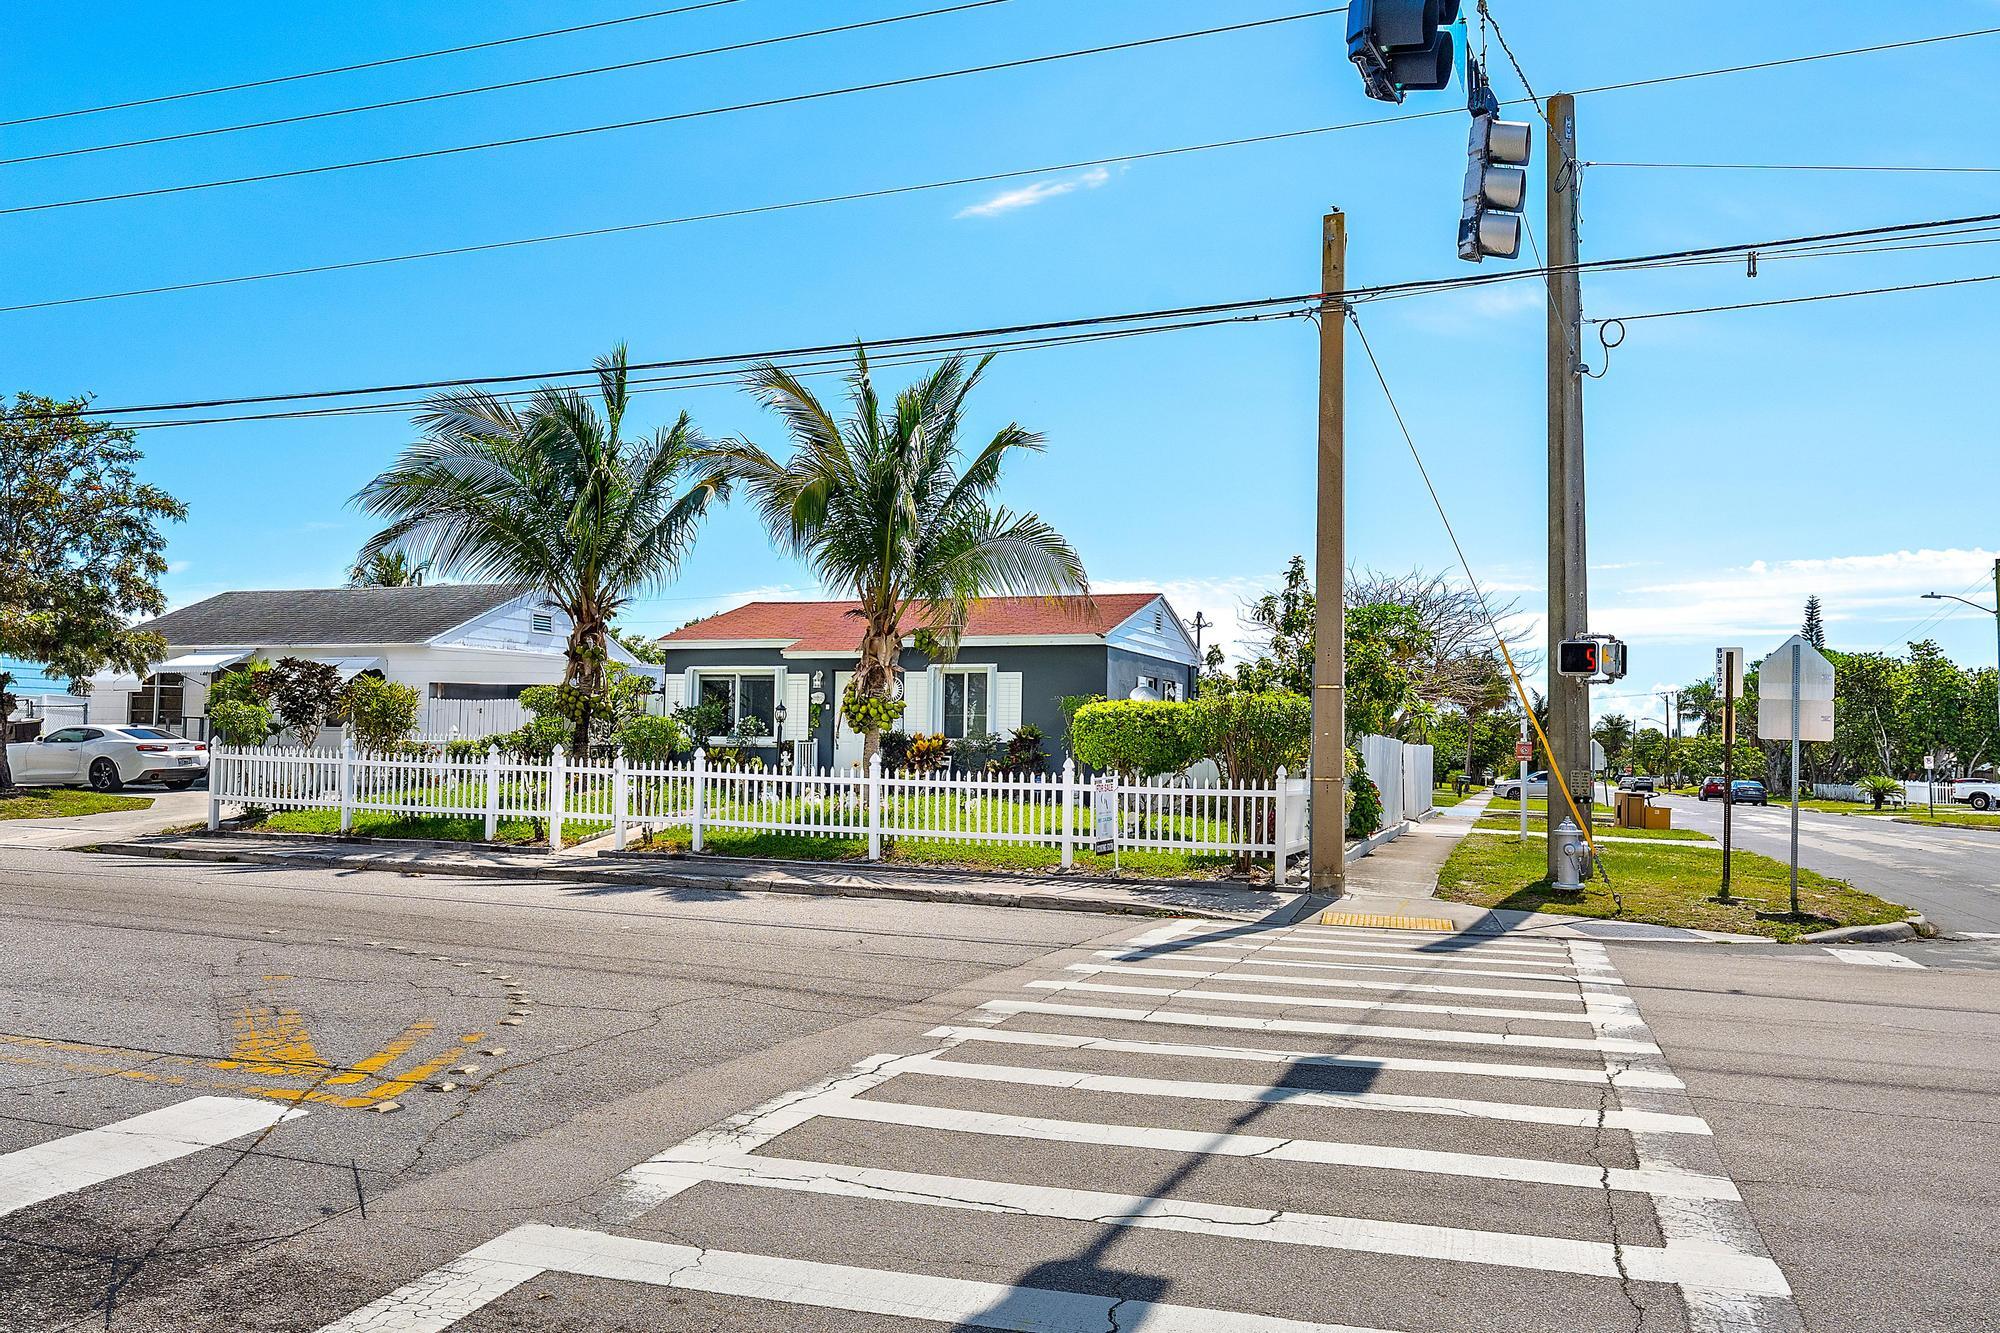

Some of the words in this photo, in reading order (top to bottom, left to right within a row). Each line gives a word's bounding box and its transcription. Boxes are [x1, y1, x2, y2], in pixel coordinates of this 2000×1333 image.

[1586, 648, 1595, 670] 5
[1096, 784, 1104, 792] FOR
[1104, 784, 1113, 792] SALE
